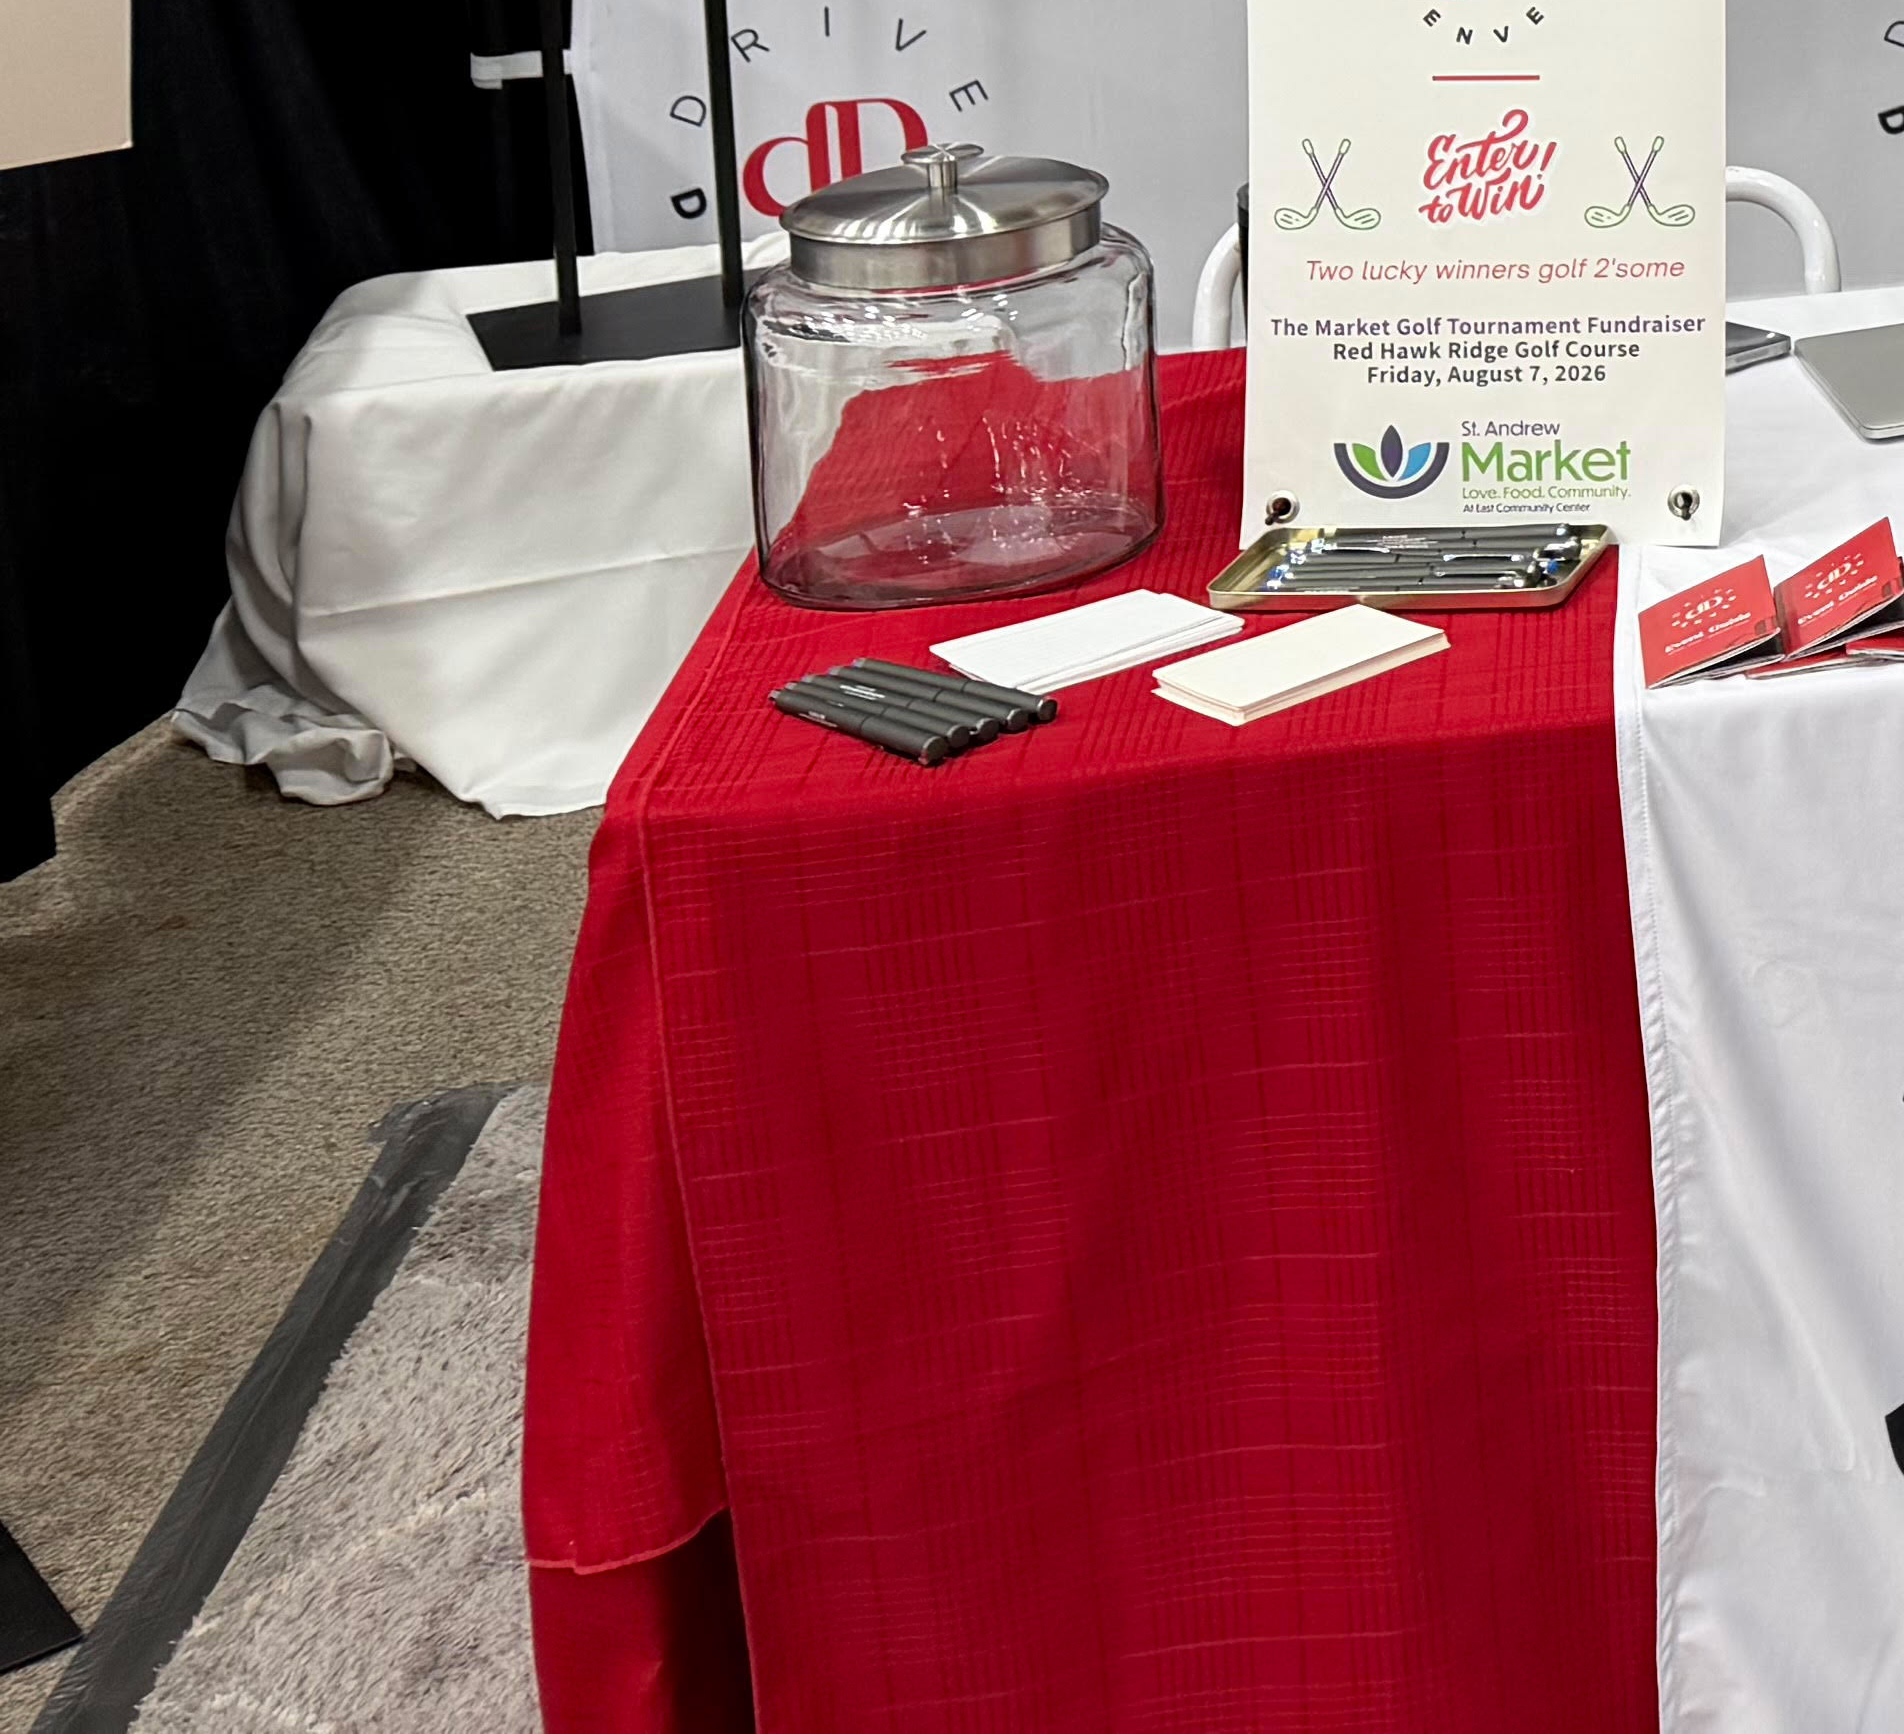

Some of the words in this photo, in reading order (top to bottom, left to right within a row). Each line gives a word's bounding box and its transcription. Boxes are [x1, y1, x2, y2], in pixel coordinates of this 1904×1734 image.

[1418, 195, 1453, 223] to
[1307, 261, 1353, 280] Two
[1363, 261, 1427, 284] lucky
[1437, 260, 1529, 279] winners
[1539, 259, 1587, 283] golf
[1594, 258, 1684, 278] 2'some
[1272, 319, 1308, 335] The
[1316, 319, 1389, 335] Market
[1397, 318, 1441, 335] Golf
[1447, 318, 1580, 334] Tournament
[1589, 315, 1705, 333] Fundraiser
[1334, 342, 1372, 359] Red
[1381, 342, 1440, 359] Hawk
[1449, 341, 1508, 363] Ridge
[1516, 340, 1559, 358] Golf
[1566, 341, 1639, 357] Course
[1369, 366, 1440, 387] Friday,
[1448, 367, 1522, 387] August
[1530, 366, 1547, 385] 7,
[1556, 365, 1605, 381] 2026
[1461, 421, 1480, 436] St.
[1484, 420, 1560, 436] Andrew
[1462, 439, 1631, 482] Market
[1462, 487, 1501, 499] Love.
[1503, 486, 1545, 499] Food.
[1548, 485, 1631, 501] Community.
[1496, 503, 1554, 514] Community
[1556, 502, 1591, 512] Center
